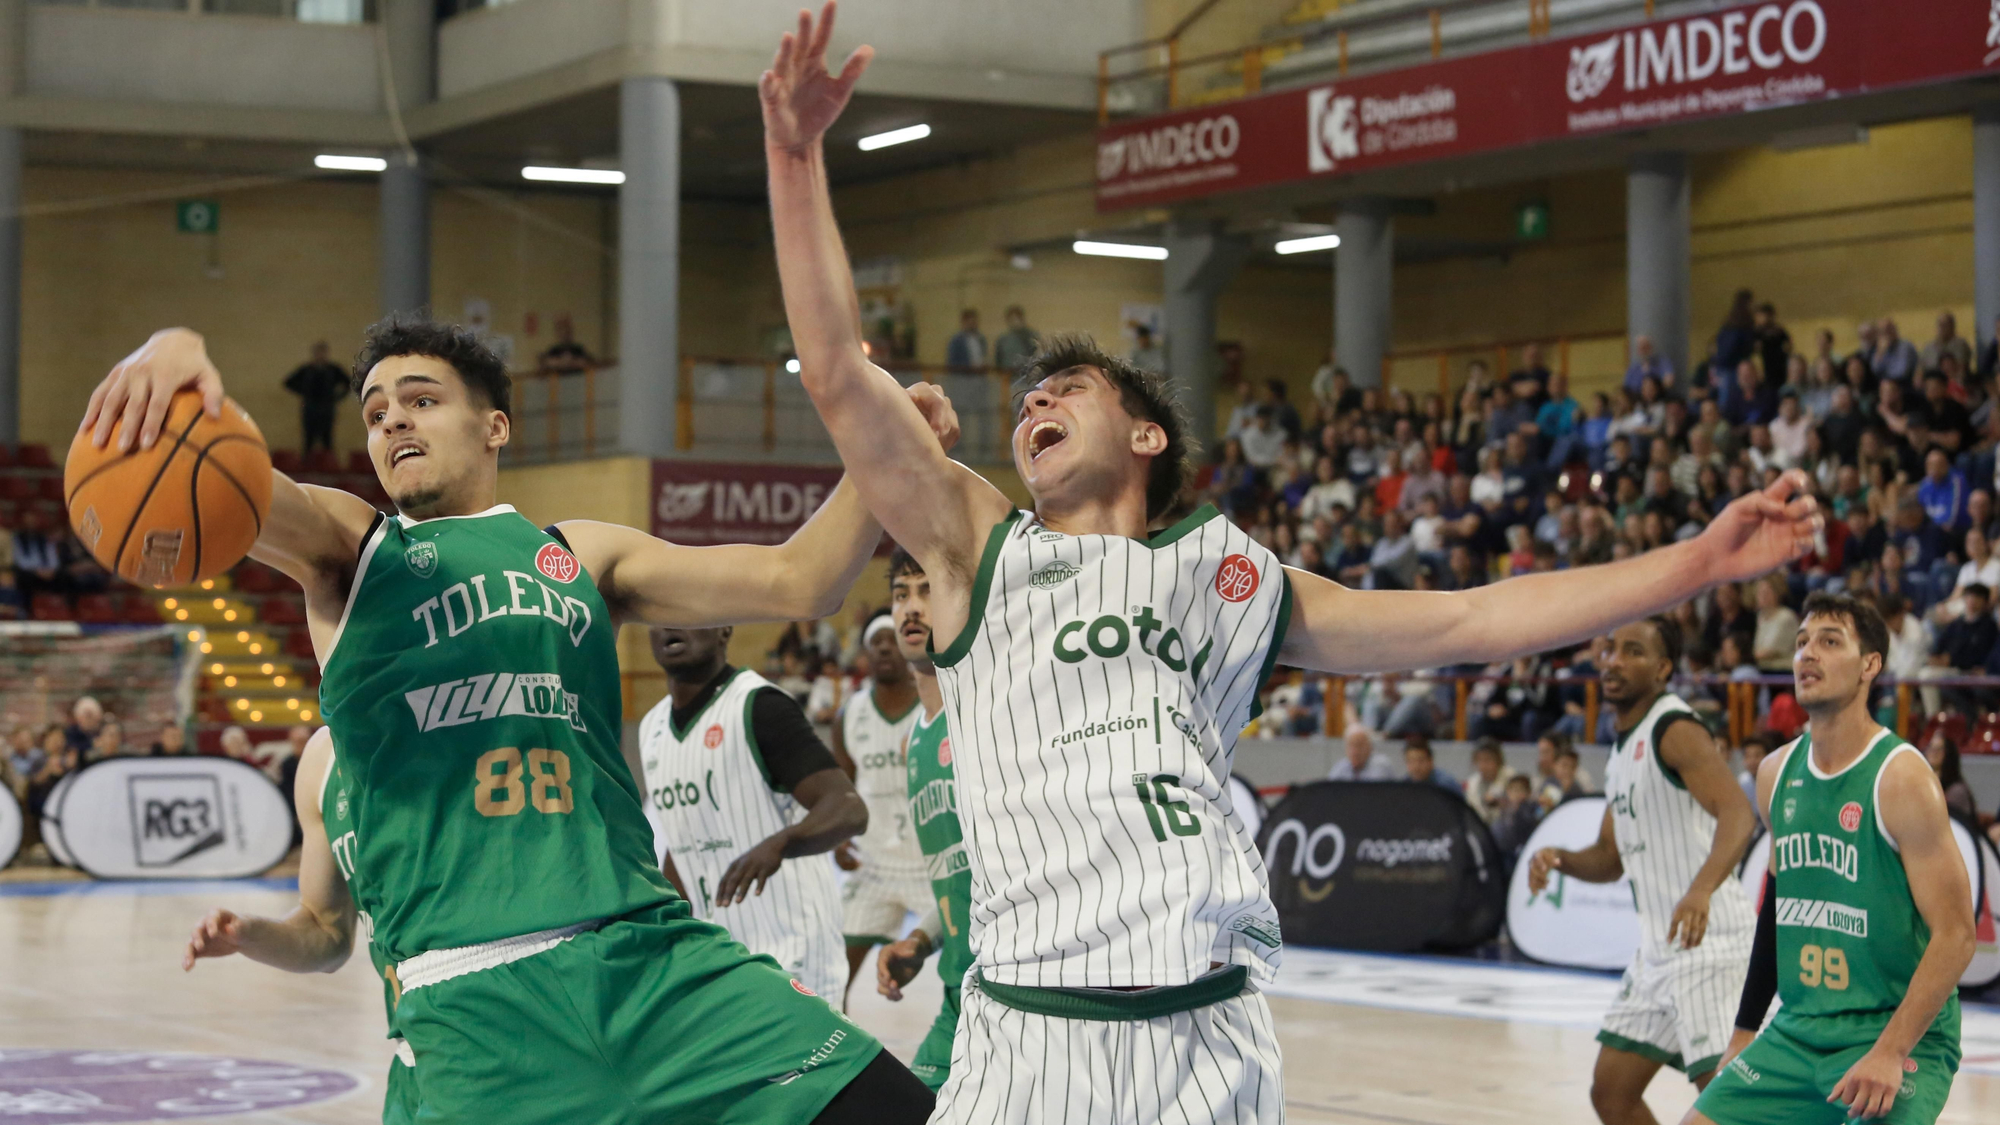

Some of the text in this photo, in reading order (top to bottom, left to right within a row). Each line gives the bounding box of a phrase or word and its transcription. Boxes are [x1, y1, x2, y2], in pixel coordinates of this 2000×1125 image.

[1623, 0, 1828, 91] IMDECO
[1127, 114, 1240, 174] IMDECO
[412, 570, 591, 649] TOLEDO
[1051, 715, 1148, 749] Fundación
[474, 746, 574, 818] 88
[1135, 773, 1202, 843] 16
[1776, 832, 1858, 883] TOLEDO
[1799, 944, 1850, 991] 99
